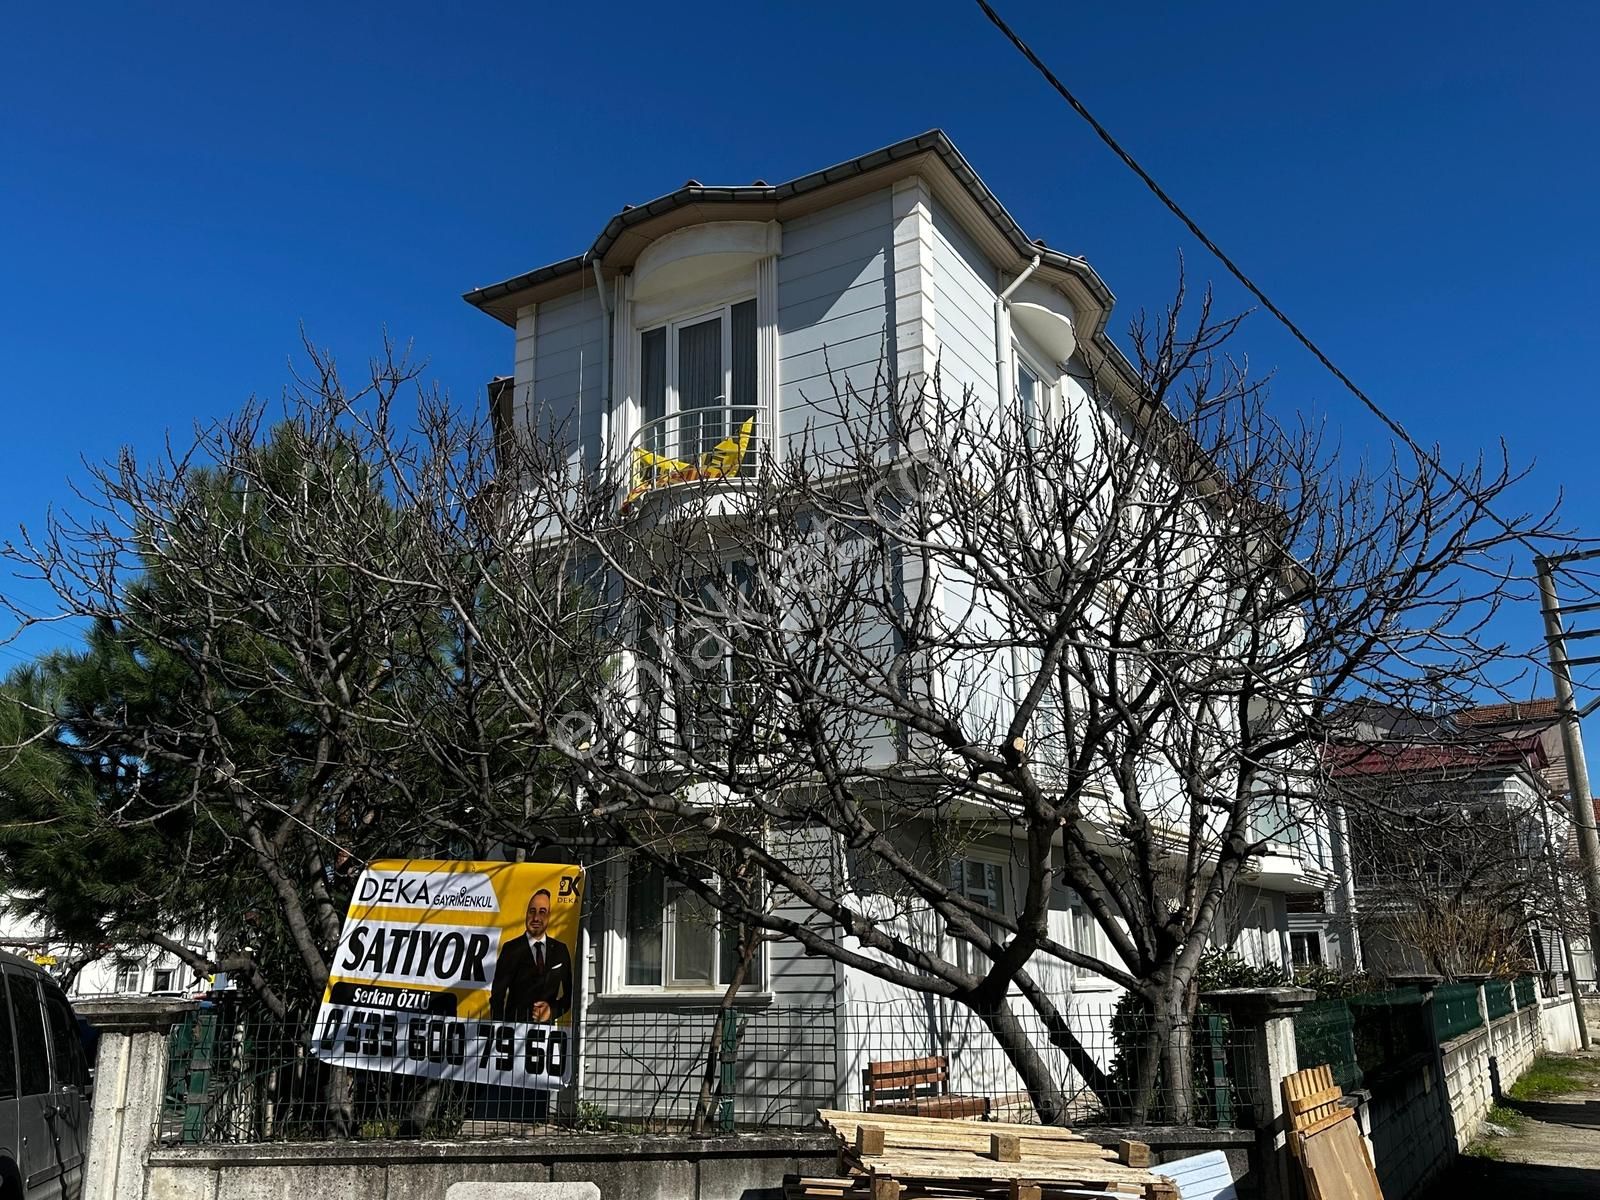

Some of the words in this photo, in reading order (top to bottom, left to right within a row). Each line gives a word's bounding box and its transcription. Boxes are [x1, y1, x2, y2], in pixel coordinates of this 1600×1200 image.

[359, 877, 430, 905] DEKA
[433, 891, 493, 908] GAYRİMENKUL
[342, 926, 490, 982] SATIYOR
[352, 987, 394, 1006] Serkan
[398, 988, 431, 1010] ÖZLÜ
[320, 1008, 344, 1051] 0
[344, 1009, 398, 1058] 533
[408, 1017, 466, 1066] 600
[477, 1023, 516, 1072] 79
[525, 1028, 568, 1077] 60
